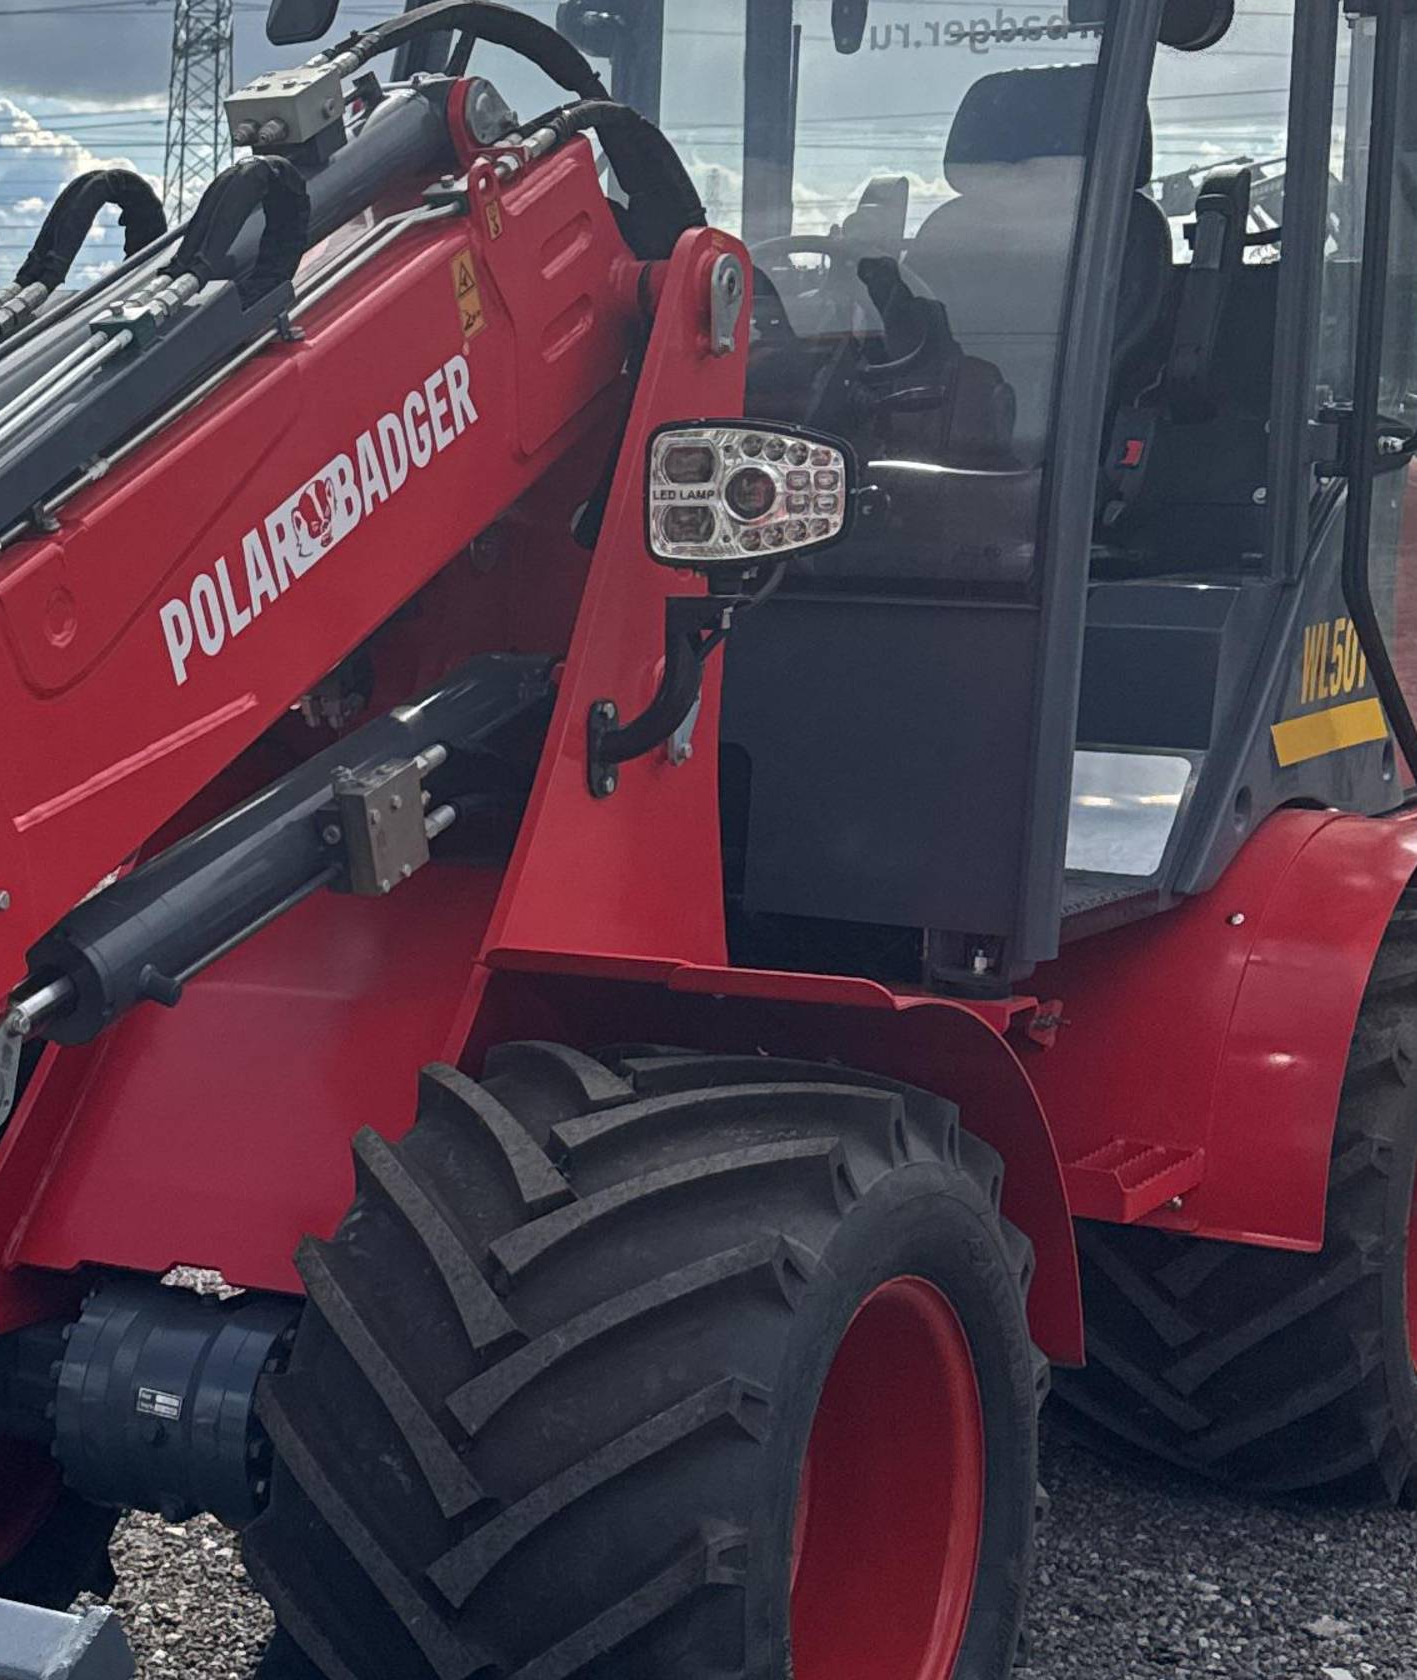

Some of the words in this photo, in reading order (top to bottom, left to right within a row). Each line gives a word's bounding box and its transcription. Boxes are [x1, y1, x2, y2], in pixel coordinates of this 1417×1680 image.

[159, 504, 294, 686] POLAR
[328, 354, 478, 530] BADGER
[653, 490, 677, 501] LED
[679, 489, 715, 500] LAMP
